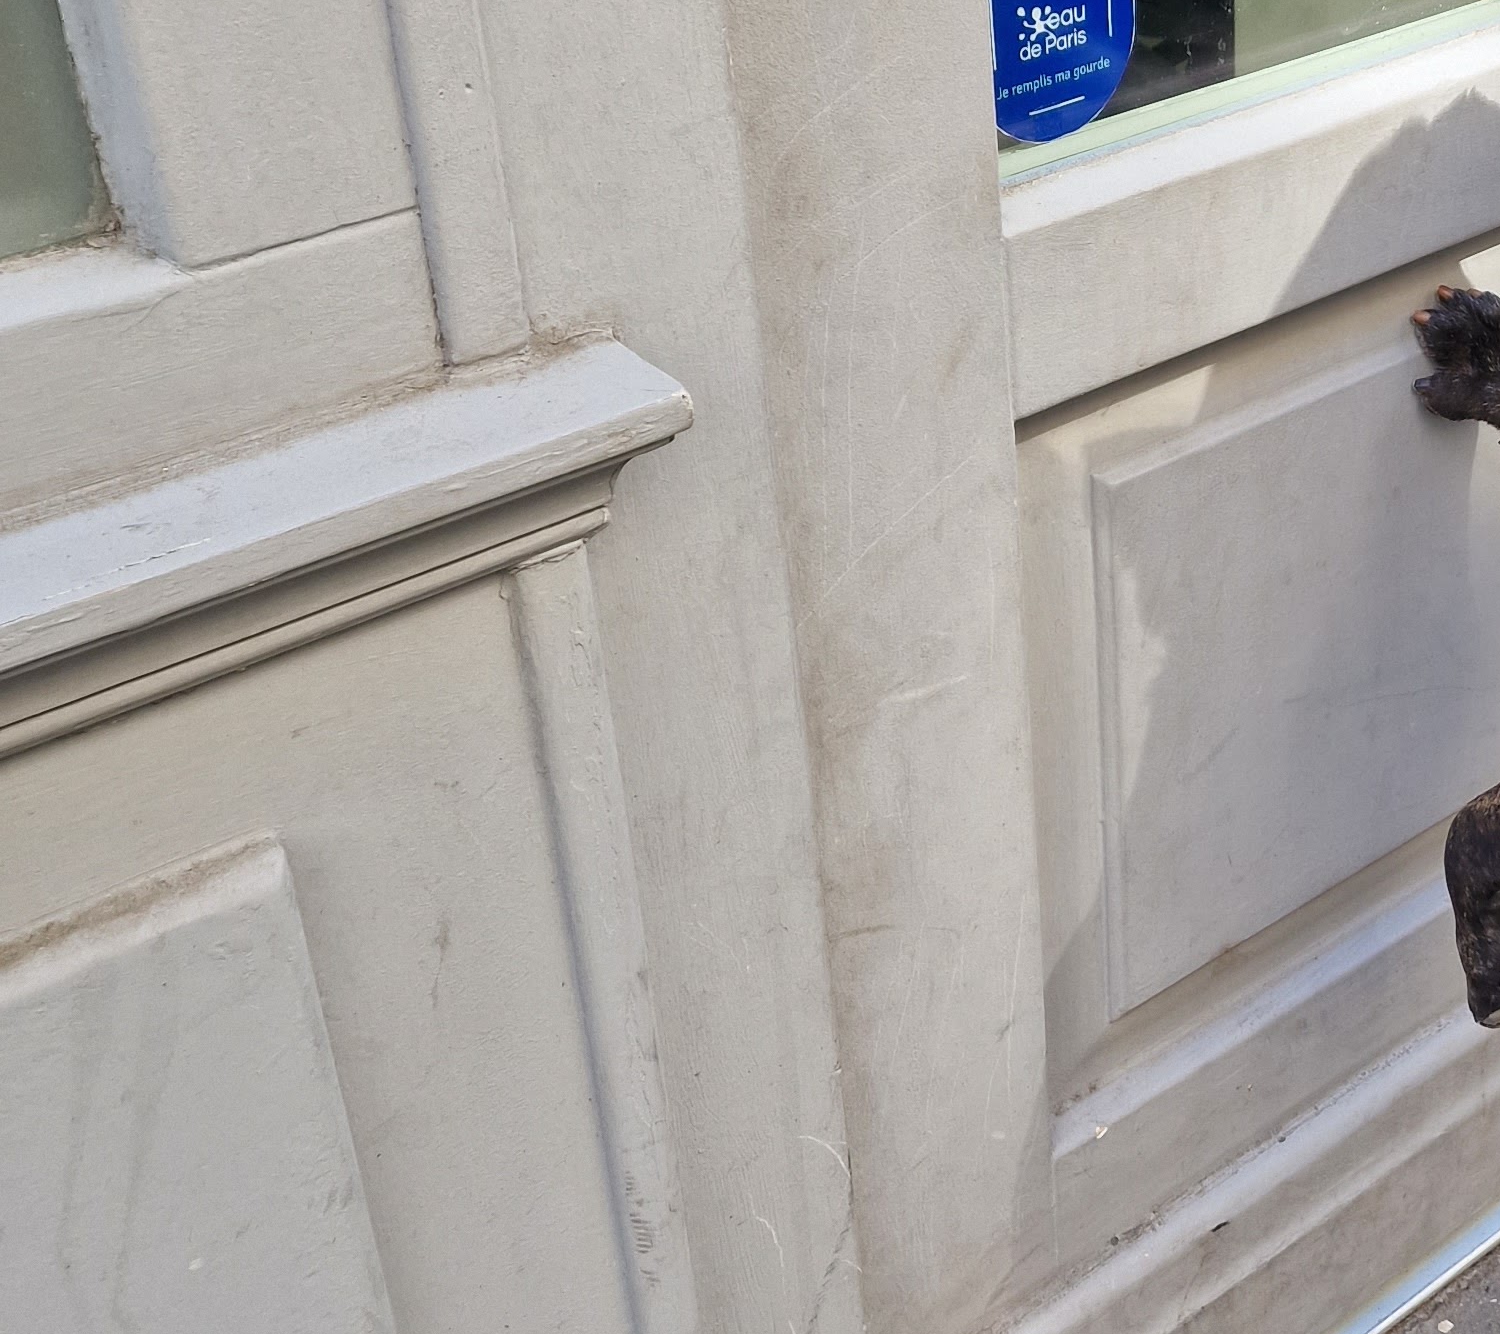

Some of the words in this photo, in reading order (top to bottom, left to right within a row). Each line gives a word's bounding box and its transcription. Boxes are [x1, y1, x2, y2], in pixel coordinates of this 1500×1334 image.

[1048, 4, 1086, 30] eau
[1019, 40, 1042, 61] de
[1045, 28, 1087, 55] Paris
[996, 87, 1009, 101] Je
[1011, 73, 1053, 94] remplis
[1055, 68, 1071, 84] ma
[1073, 55, 1111, 81] gourde
